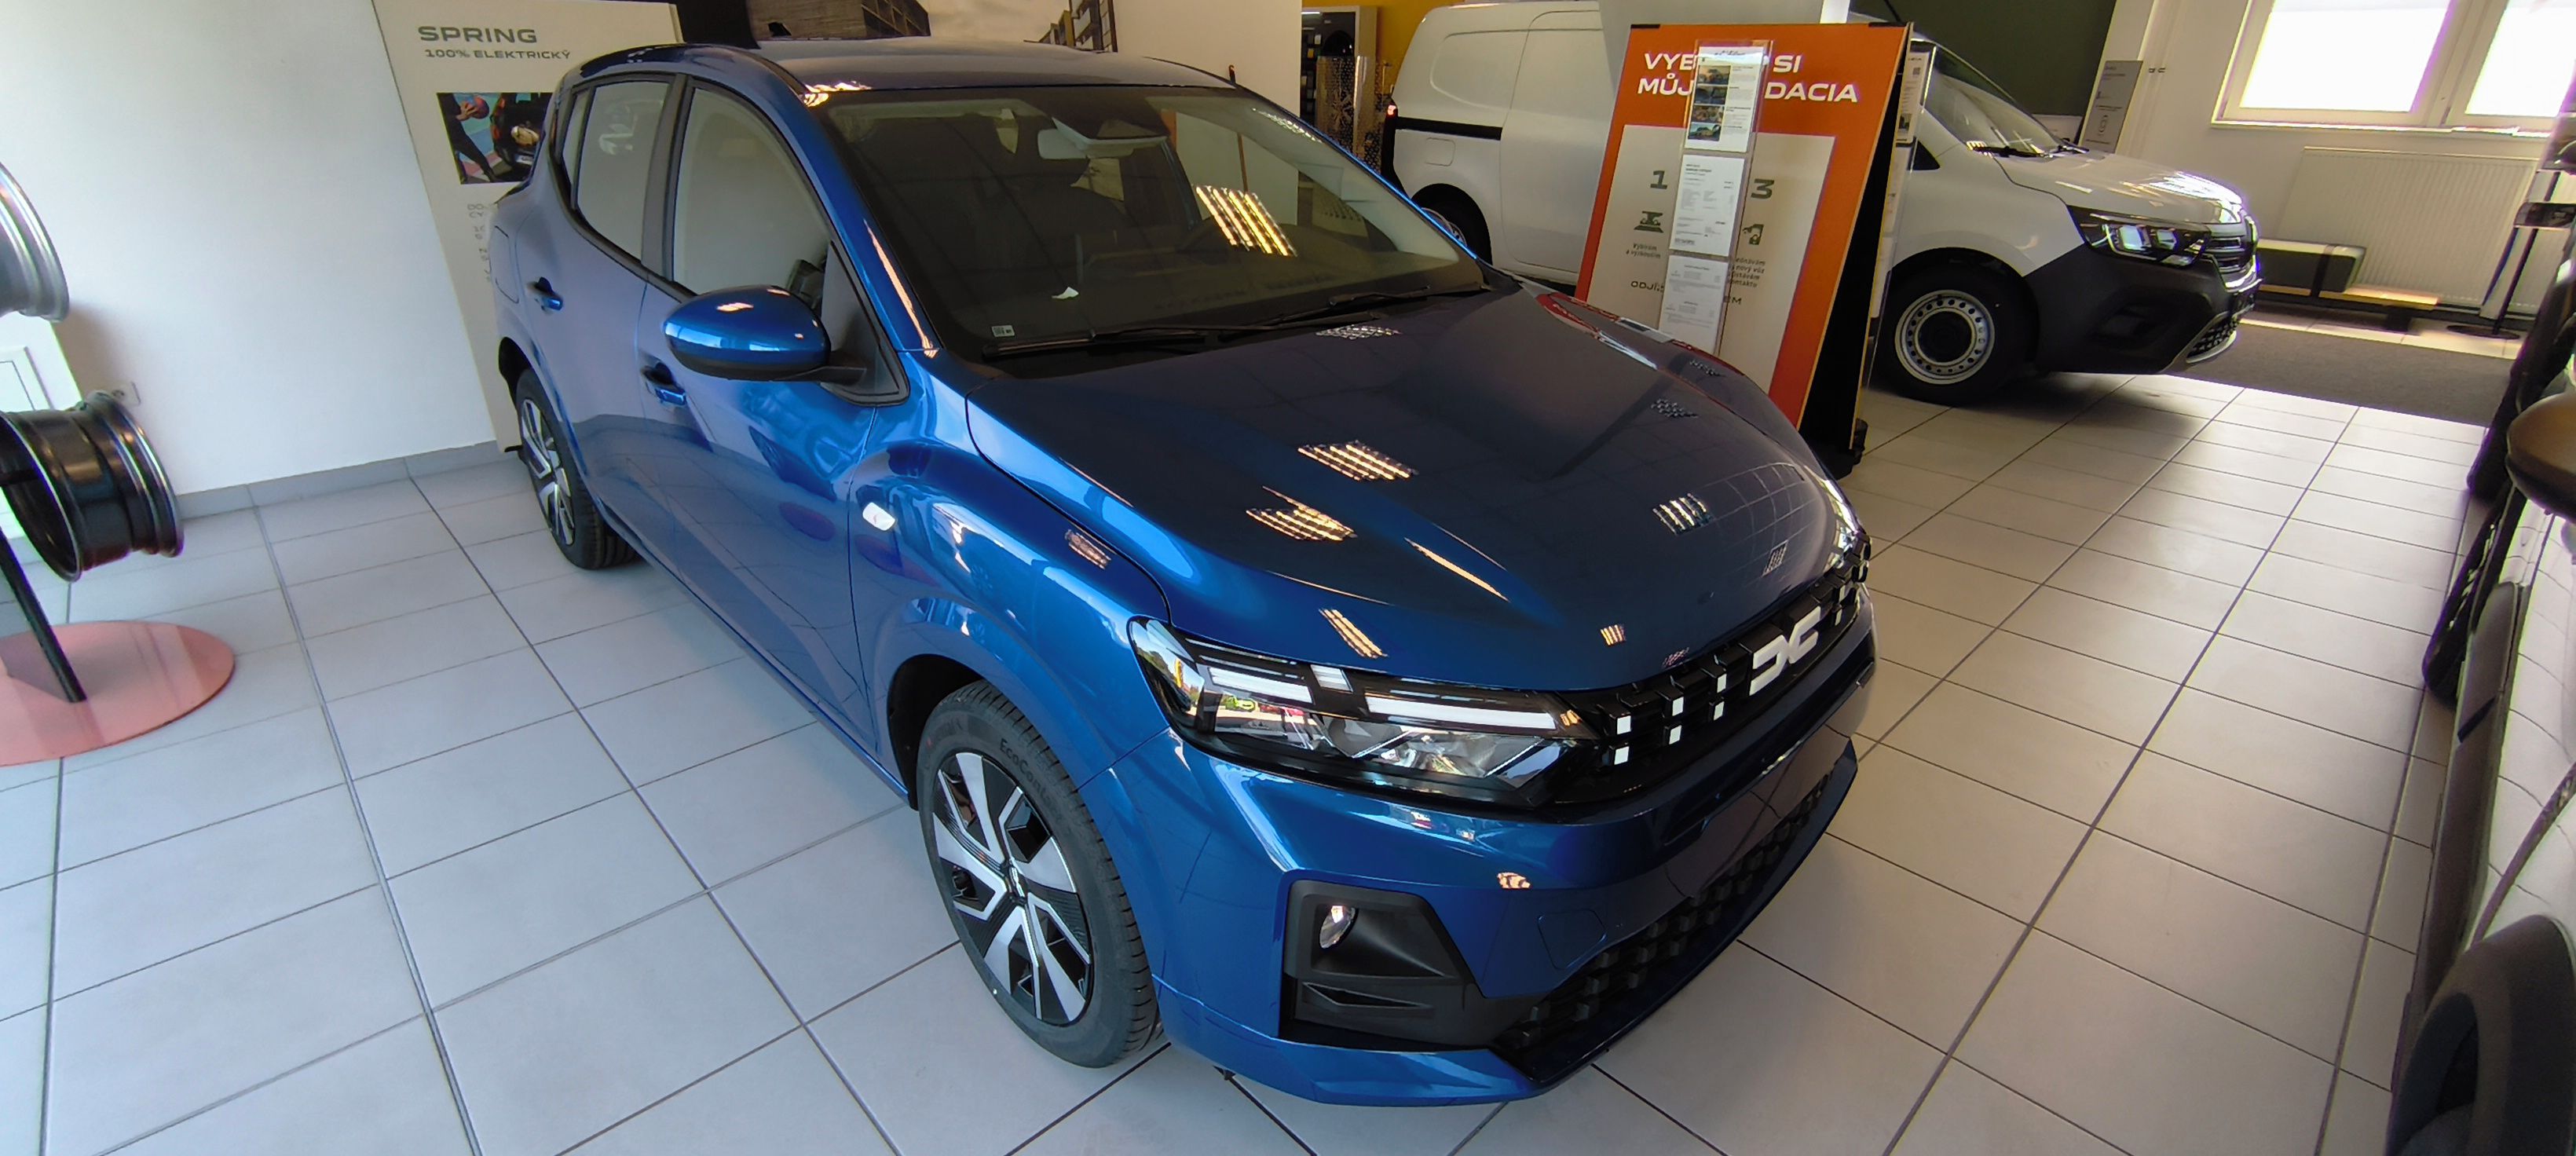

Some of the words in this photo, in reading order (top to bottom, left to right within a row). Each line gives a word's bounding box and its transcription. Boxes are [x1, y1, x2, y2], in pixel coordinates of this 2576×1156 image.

[418, 26, 537, 43] SPRING
[425, 49, 470, 58] 100%
[473, 49, 571, 60] ELEKTRICKÝ
[1773, 54, 1802, 73] SI
[1637, 72, 1695, 96] MŮJ
[1764, 81, 1858, 103] DACIA
[1650, 170, 1668, 190] 1
[1751, 178, 1775, 199] 3
